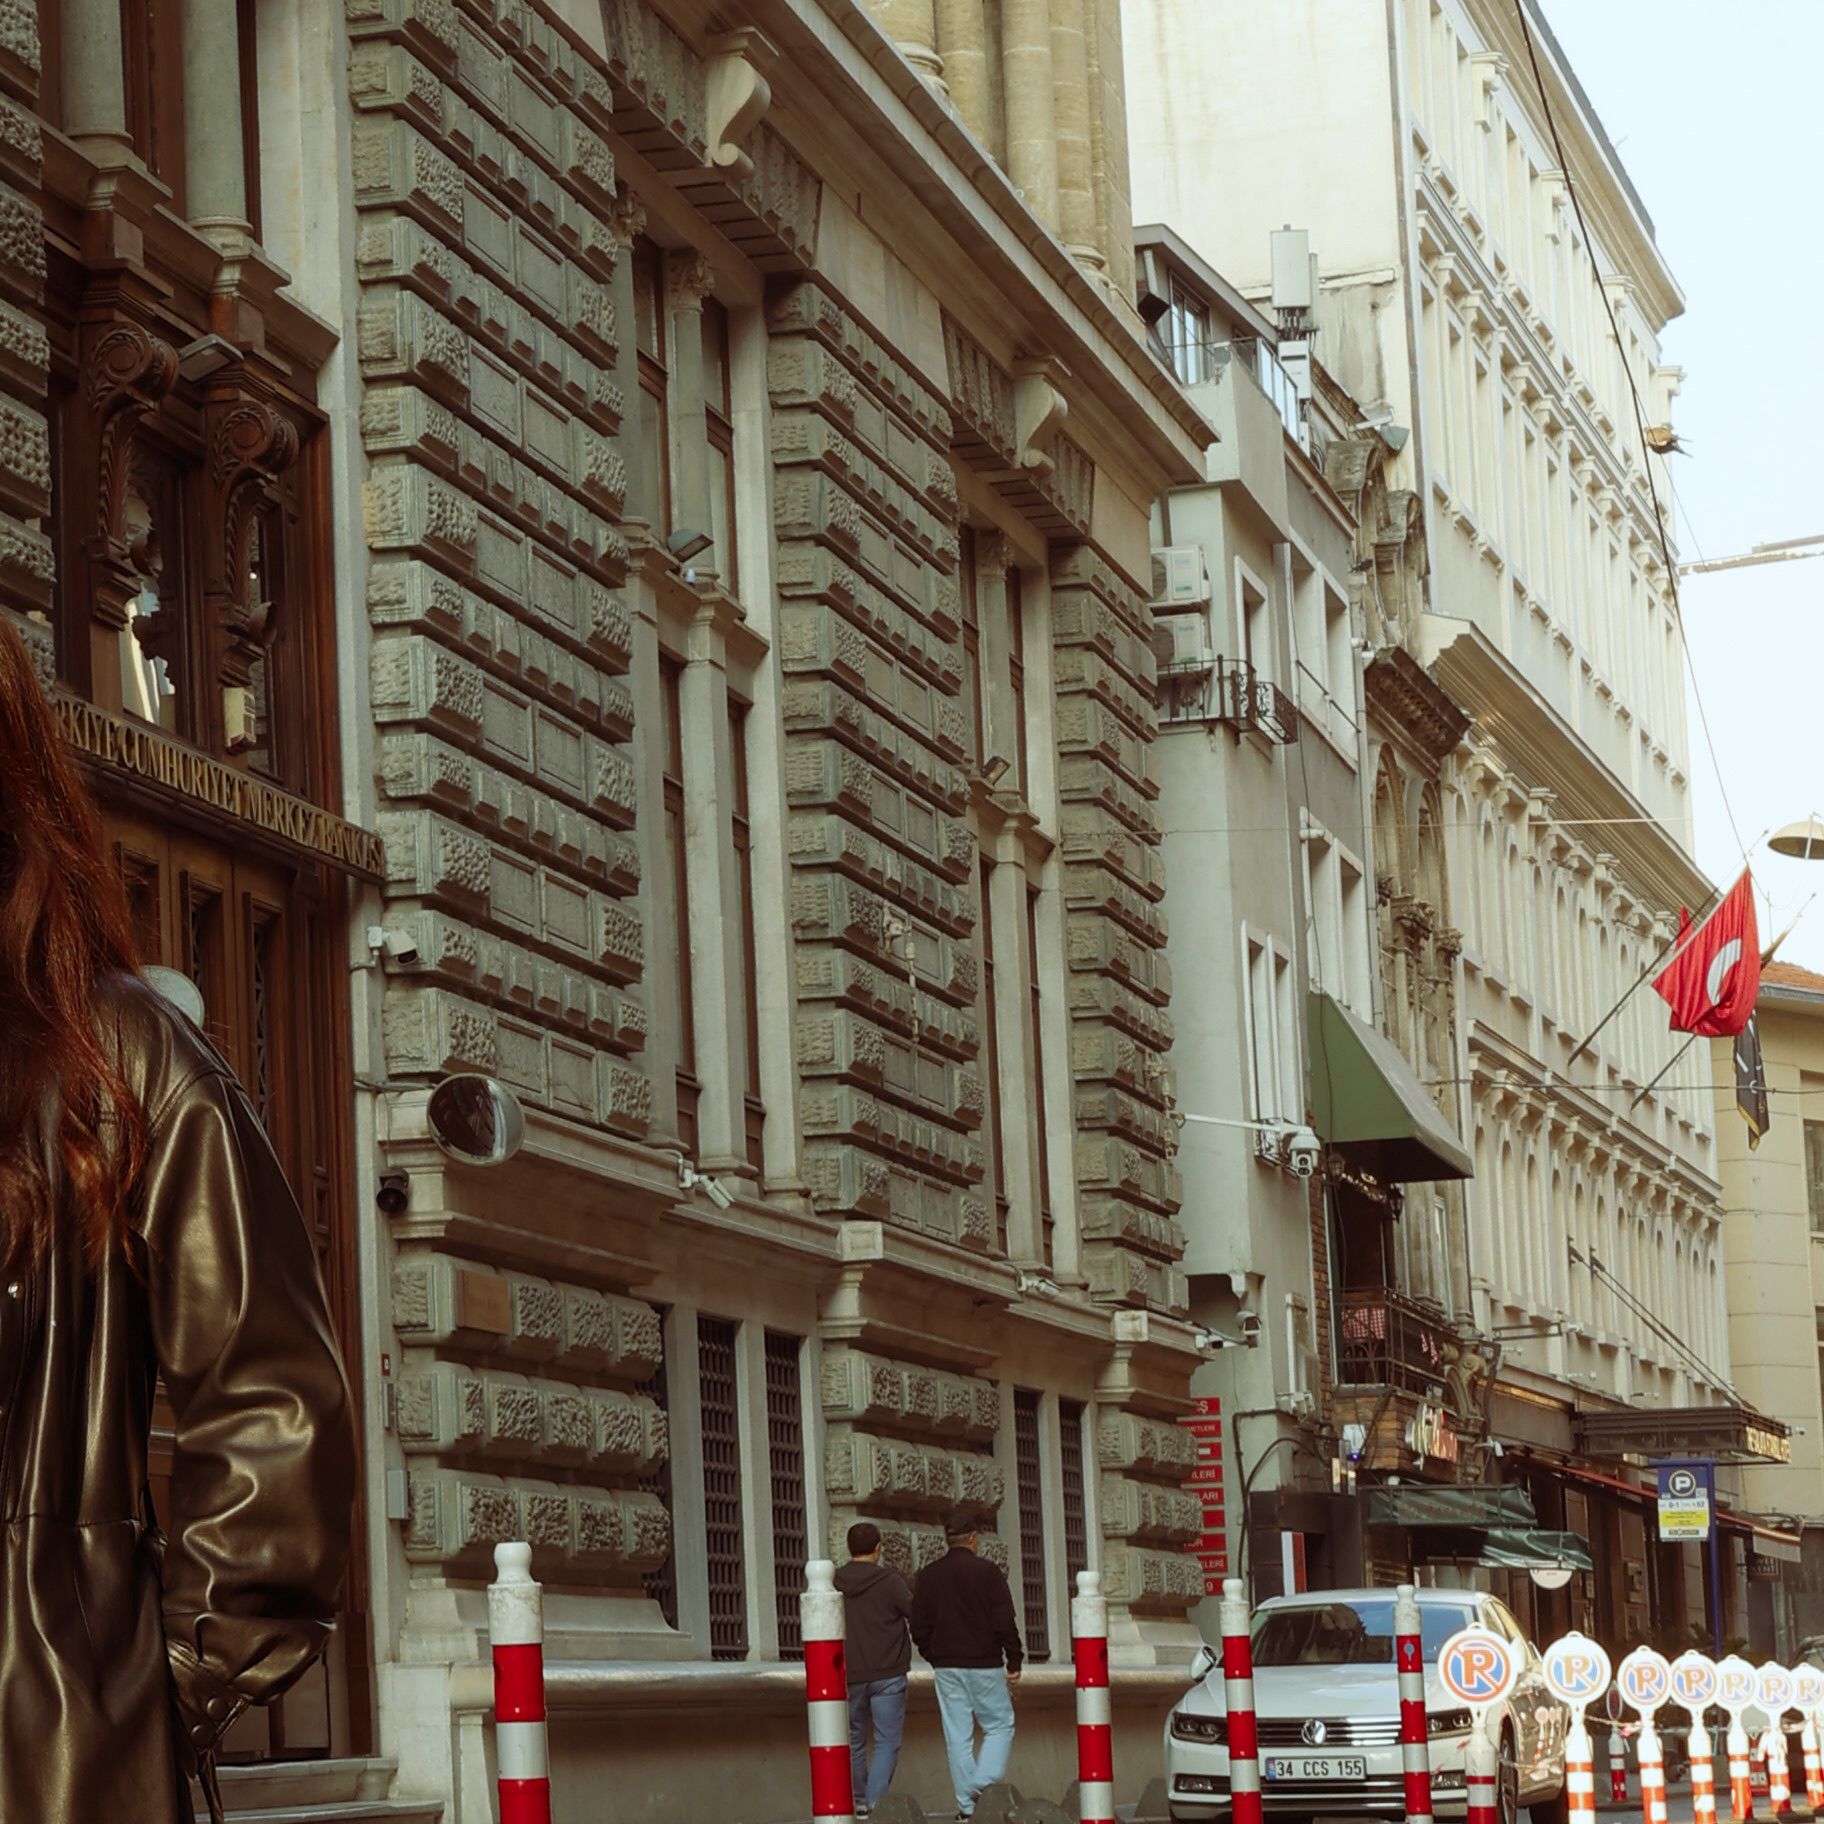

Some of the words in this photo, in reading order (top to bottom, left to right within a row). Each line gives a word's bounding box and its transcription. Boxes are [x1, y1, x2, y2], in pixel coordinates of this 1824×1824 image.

[1675, 1476, 1692, 1492] P
[1277, 1761, 1294, 1777] 34
[1303, 1761, 1329, 1777] CCS
[1337, 1760, 1363, 1776] 155
